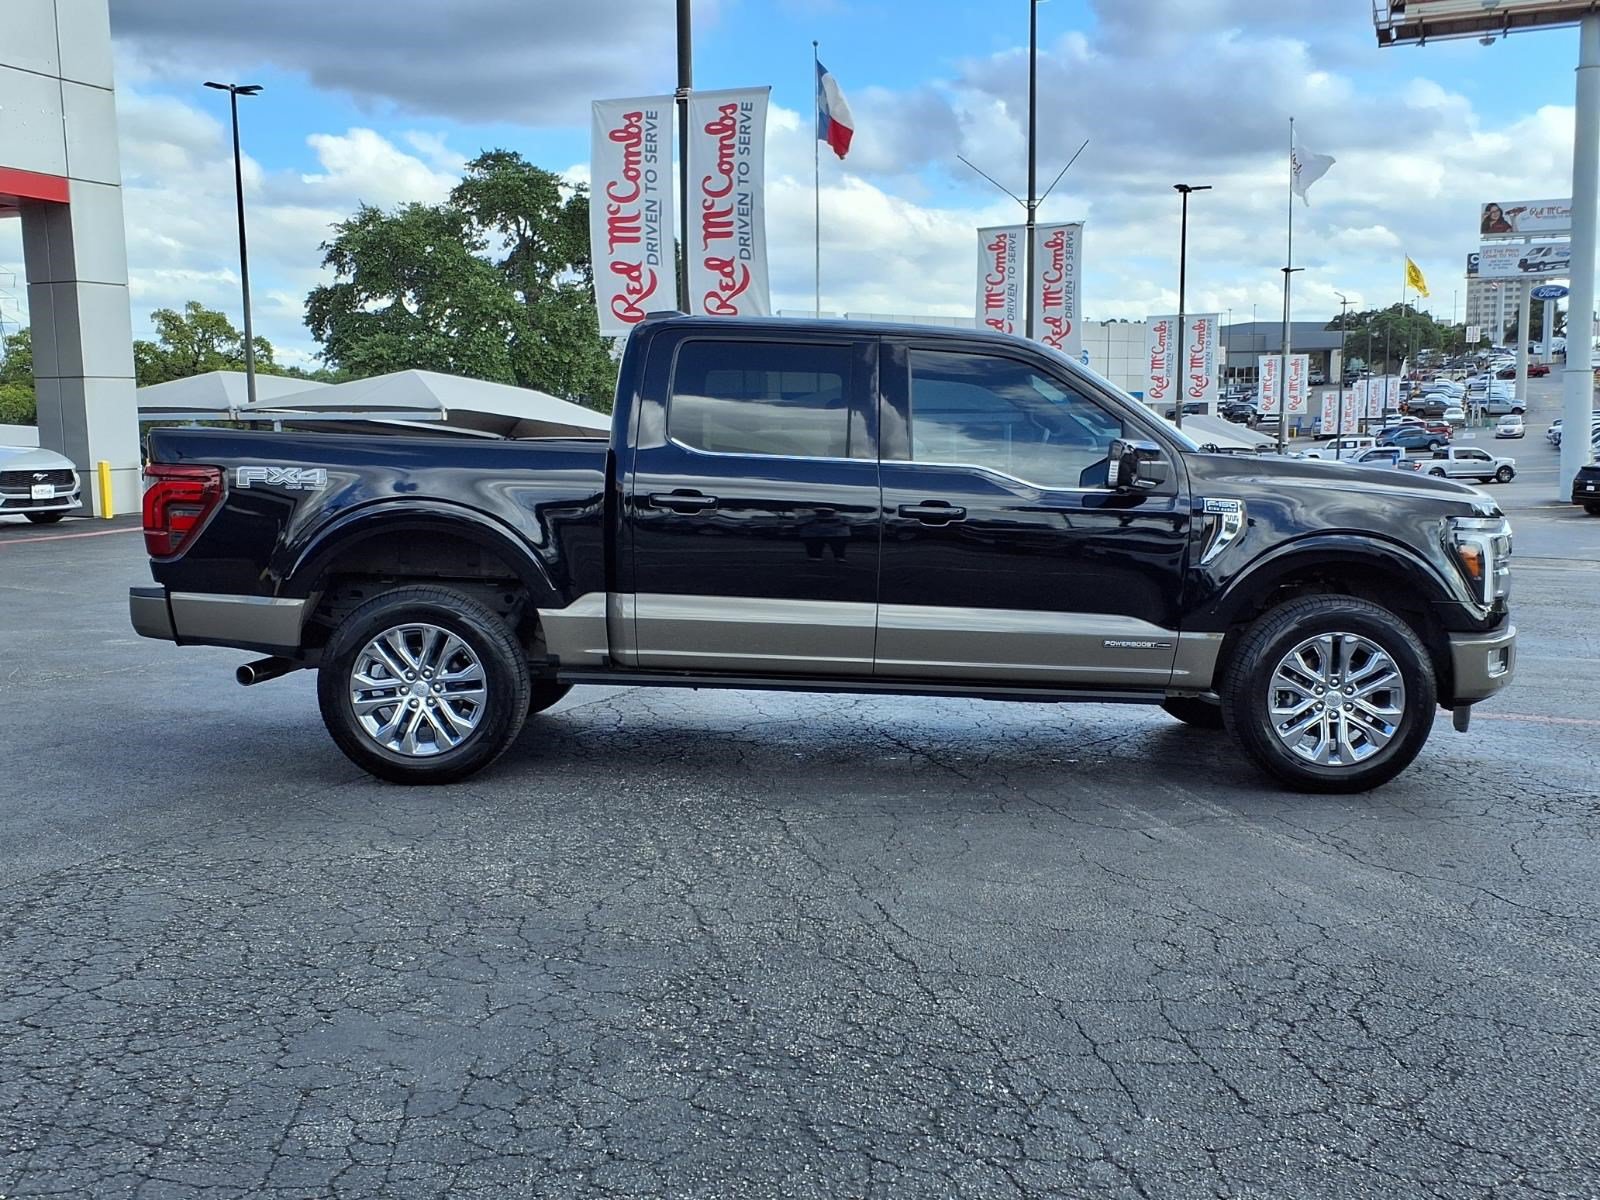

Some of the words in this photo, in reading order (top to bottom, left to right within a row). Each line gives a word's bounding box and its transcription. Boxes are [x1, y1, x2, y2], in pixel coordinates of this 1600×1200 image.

[645, 110, 658, 164] SERVE
[738, 101, 753, 156] SERVE
[606, 111, 643, 255] McCombs
[645, 169, 658, 193] TO
[702, 103, 738, 252] McCombs
[738, 162, 750, 187] TO
[645, 199, 659, 266] DRIVEN
[737, 193, 752, 261] DRIVEN
[1066, 230, 1074, 261] SERVE
[1008, 232, 1017, 264] SERVE
[704, 256, 750, 316] Red
[985, 233, 1007, 314] McCombs
[1007, 265, 1015, 279] TO
[1042, 230, 1065, 313] McCombs
[1065, 263, 1074, 278] TO
[610, 260, 658, 324] Red
[1007, 283, 1015, 320] DRIVEN
[1065, 280, 1073, 318] DRIVEN
[1538, 287, 1562, 297] Ford
[1041, 316, 1071, 350] Red
[1150, 320, 1167, 374] McCombs
[1189, 318, 1206, 373] McCombs
[1149, 375, 1169, 399] Red
[1188, 374, 1209, 398] Red
[236, 466, 328, 489] FX4
[1104, 640, 1157, 648] POWERBOOST
